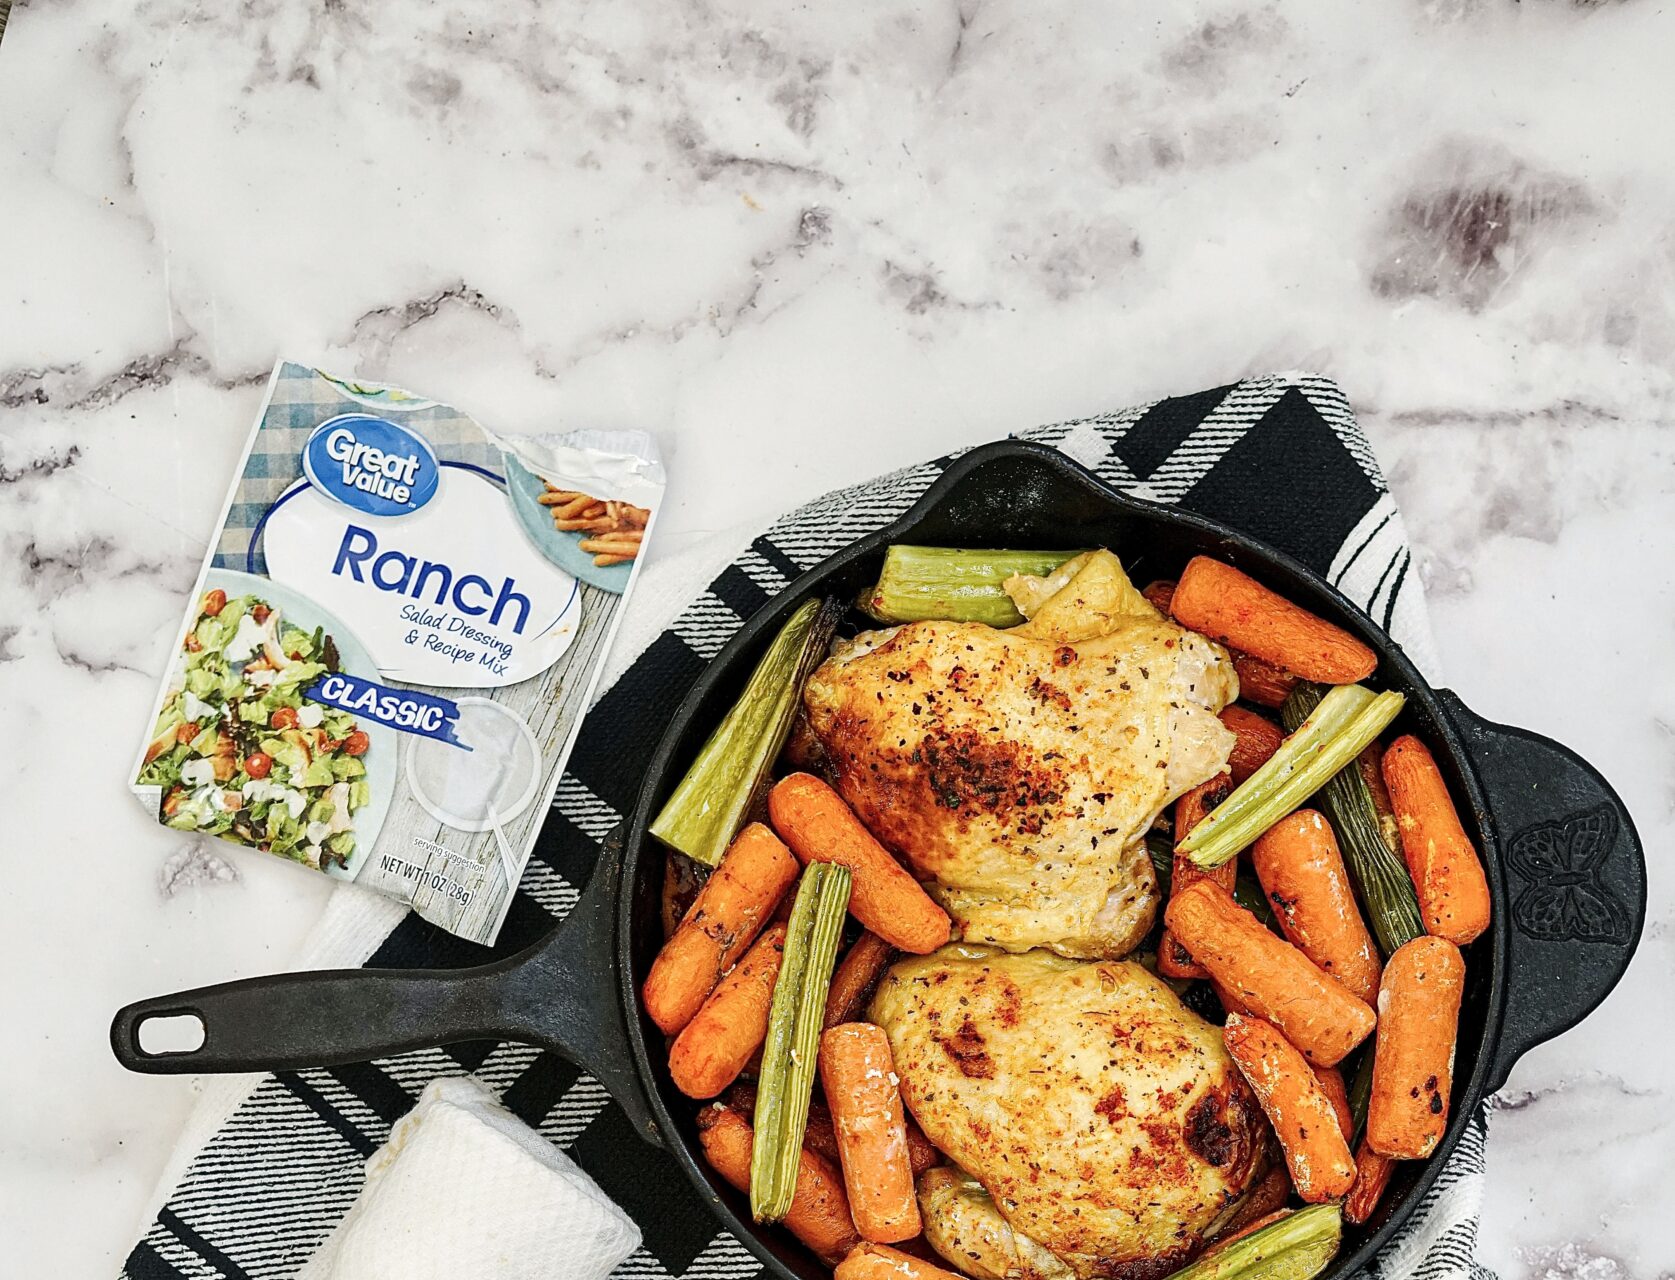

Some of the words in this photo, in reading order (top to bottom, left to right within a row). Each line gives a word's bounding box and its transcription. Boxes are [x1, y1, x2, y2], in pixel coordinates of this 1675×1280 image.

[326, 428, 420, 486] Great
[342, 463, 411, 503] Value
[332, 524, 531, 635] Ranch
[400, 604, 448, 630] Salad
[447, 617, 513, 660] Dressing
[404, 629, 418, 645] &
[424, 634, 475, 664] Recipe
[479, 652, 509, 677] Mix
[321, 677, 444, 732] CLASSIC
[380, 854, 404, 874] NET
[403, 862, 423, 882] WT
[423, 871, 430, 885] 1
[431, 875, 447, 892] OZ
[446, 881, 475, 907] (28g)
[413, 838, 443, 857] serving
[443, 850, 485, 873] suggestion
